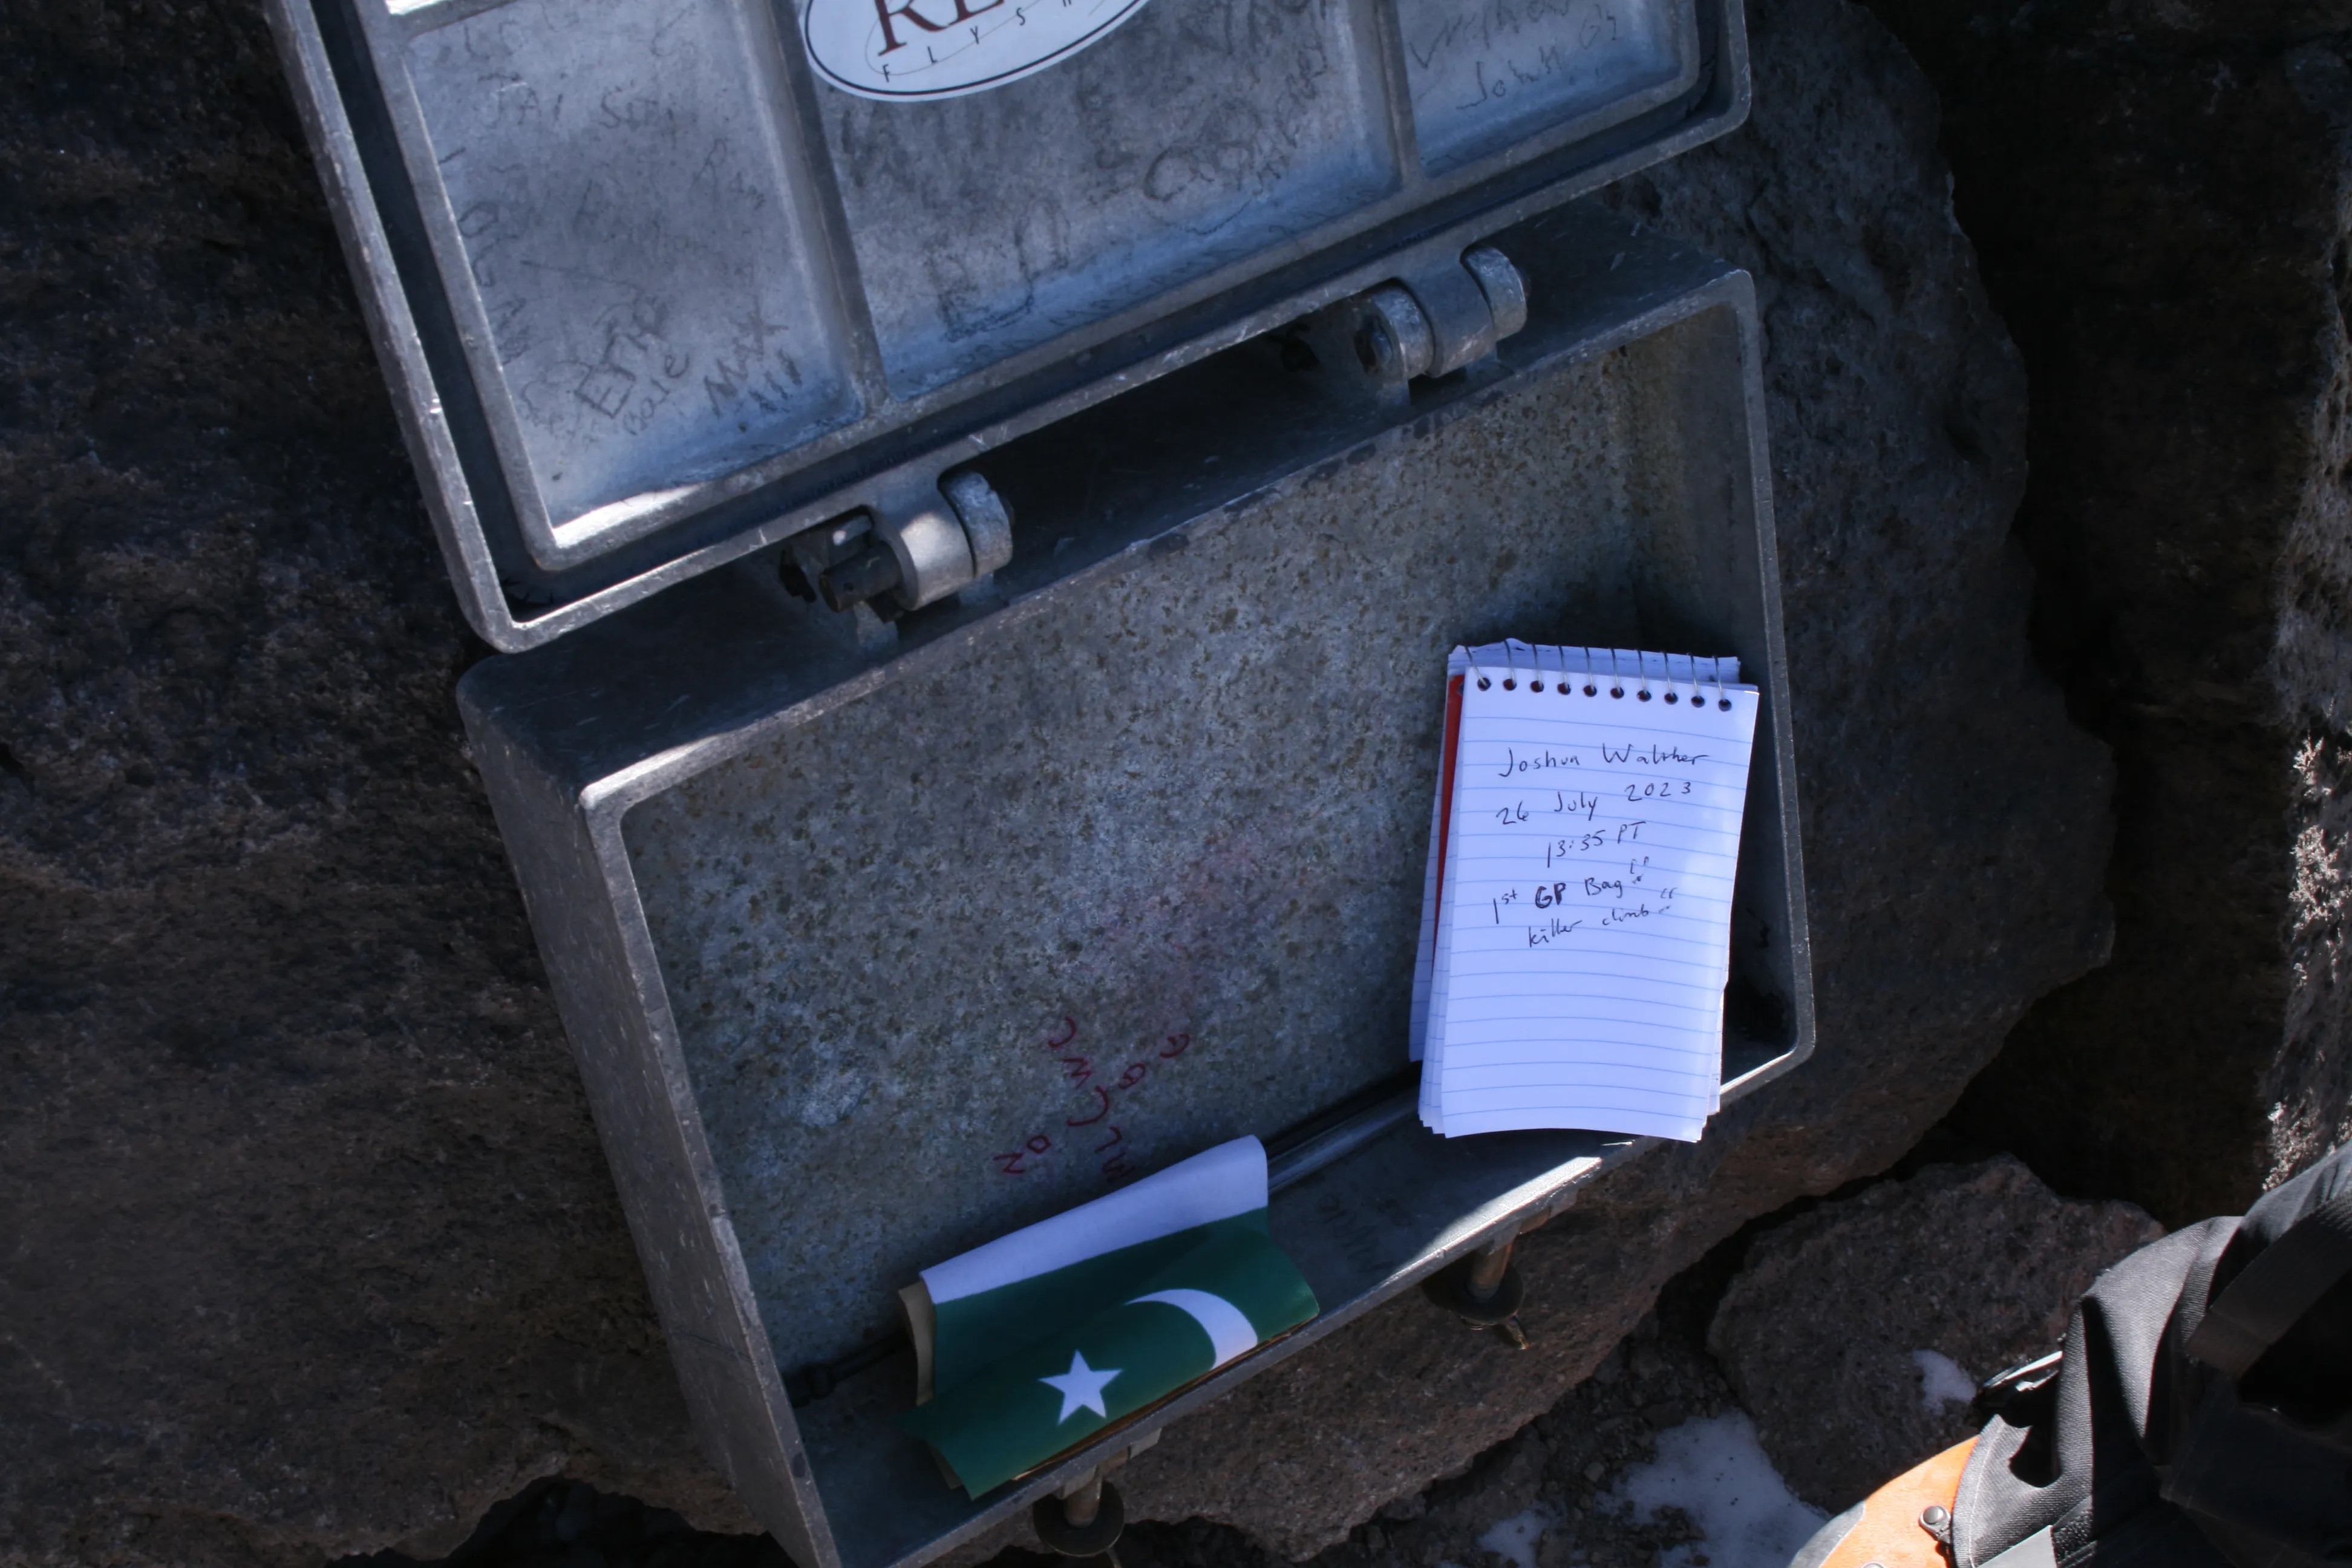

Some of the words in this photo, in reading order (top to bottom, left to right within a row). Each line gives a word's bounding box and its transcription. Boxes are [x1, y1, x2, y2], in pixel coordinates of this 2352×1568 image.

[1498, 747, 1580, 778] Joshua
[1496, 800, 1529, 825] 26
[1553, 791, 1598, 822] July
[1624, 781, 1691, 802] 2023
[1547, 829, 1606, 869] 13:35
[1617, 821, 1647, 844] PT
[1492, 887, 1518, 924] 1st
[1535, 881, 1567, 909] GP
[1528, 918, 1583, 949] killer
